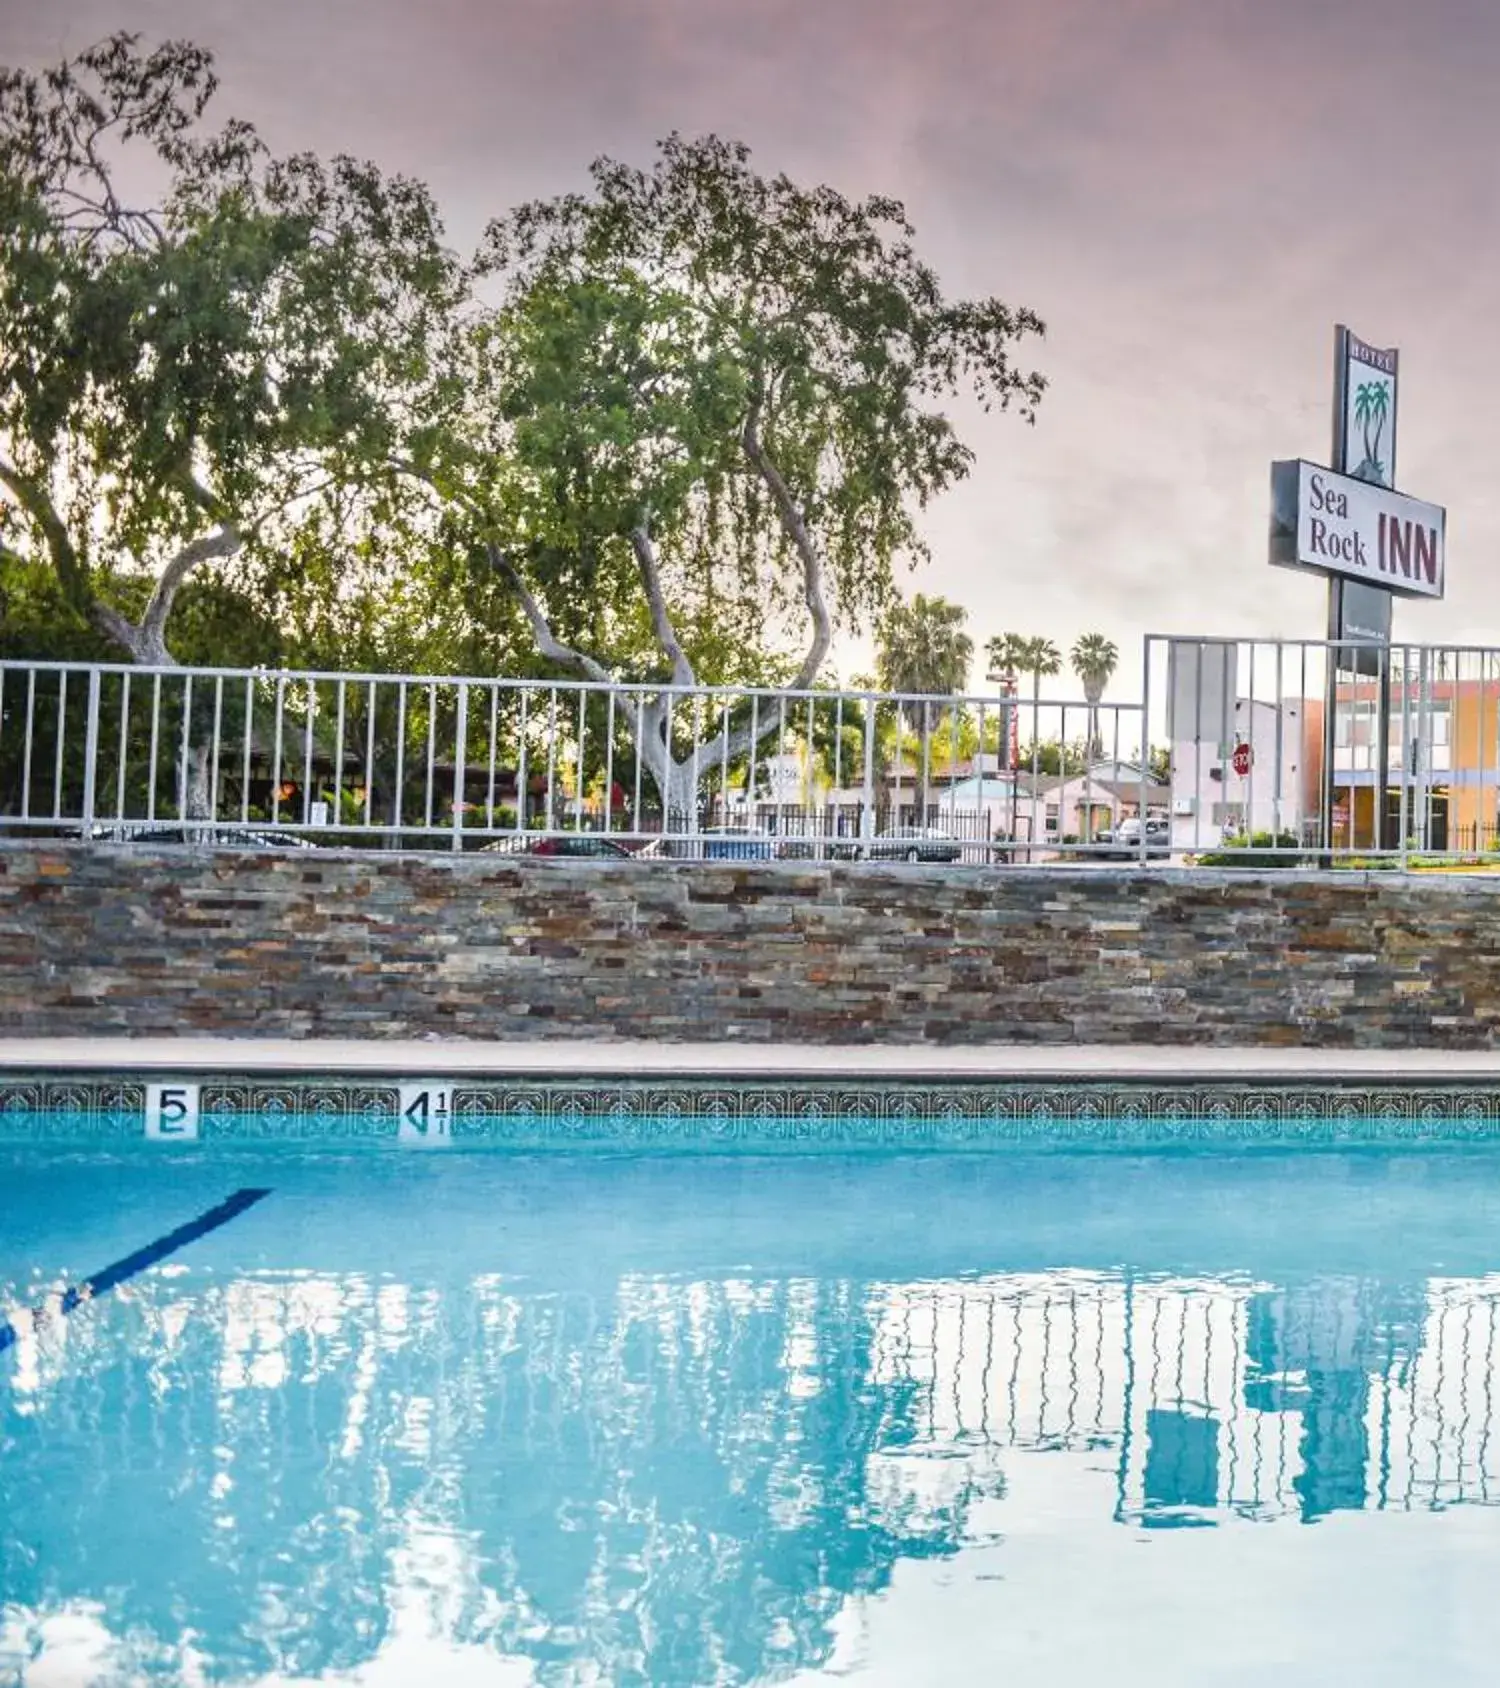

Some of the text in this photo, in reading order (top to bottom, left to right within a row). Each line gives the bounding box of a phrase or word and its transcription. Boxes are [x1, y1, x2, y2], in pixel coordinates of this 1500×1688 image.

[1310, 473, 1348, 518] Sea
[1310, 517, 1367, 566] Rock
[1378, 511, 1437, 585] INN
[160, 1090, 187, 1122] 5
